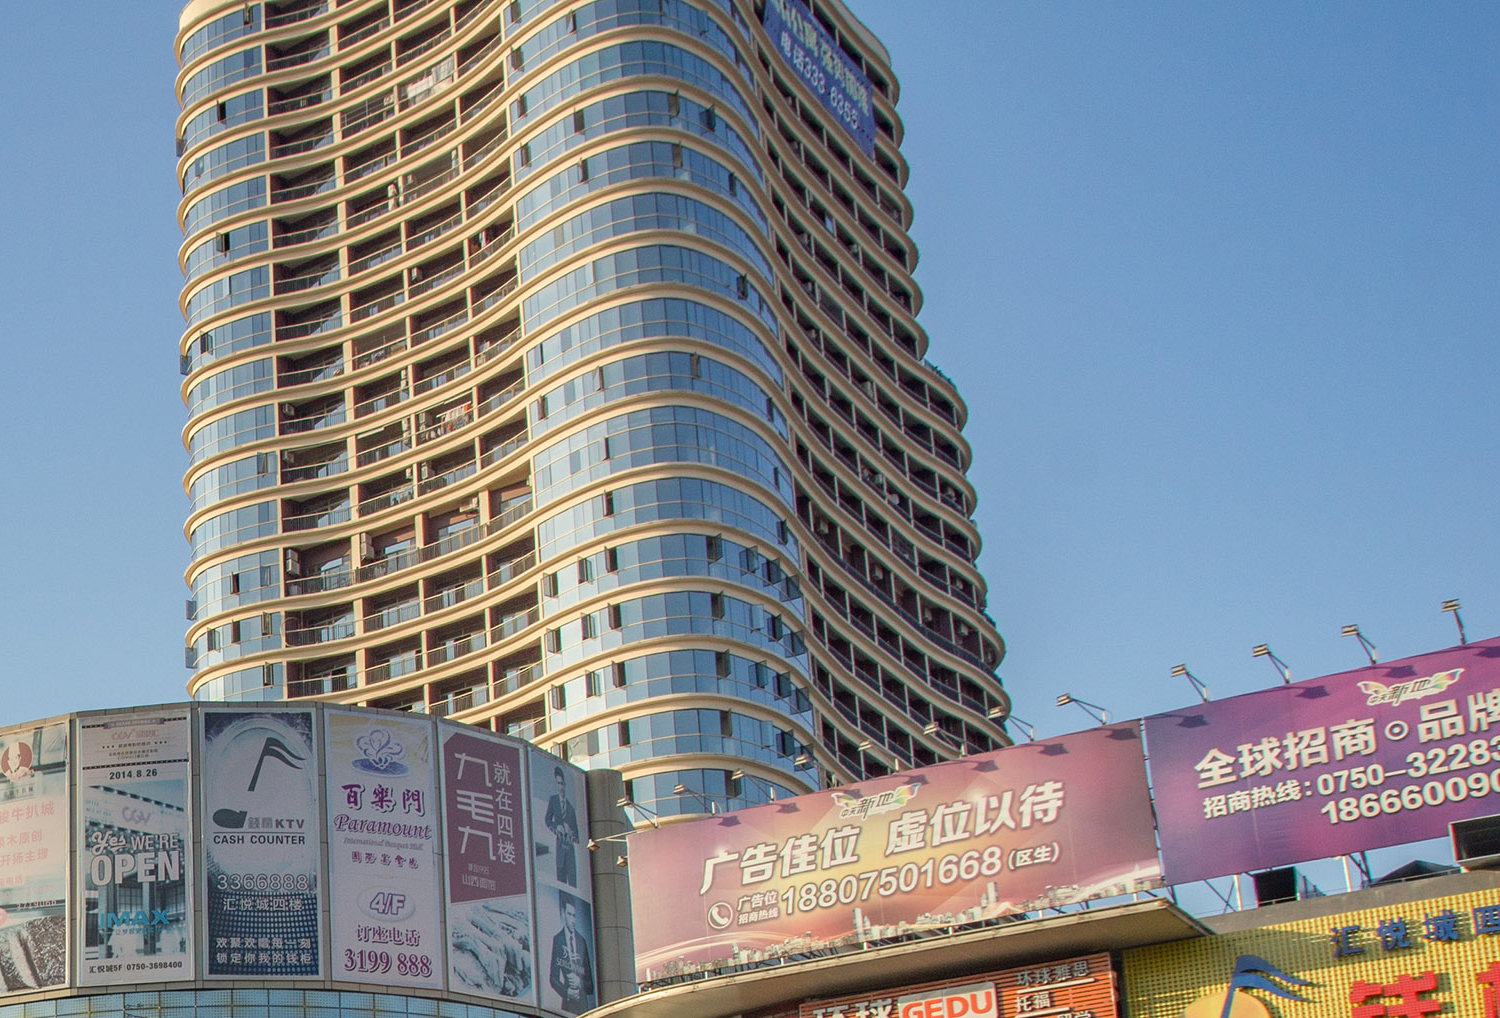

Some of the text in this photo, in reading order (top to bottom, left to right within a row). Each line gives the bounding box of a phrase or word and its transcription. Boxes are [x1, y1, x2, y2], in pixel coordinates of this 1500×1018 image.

[1194, 717, 1378, 790] 全球招商
[454, 752, 497, 861] 九毛九
[493, 761, 517, 866] 就在四楼
[213, 834, 306, 845] CASH COUNTER
[333, 813, 432, 841] Paramount
[700, 780, 1067, 896] 广告佳位 虚位以待
[90, 850, 181, 886] OPEN
[216, 873, 309, 891] 3366888
[780, 846, 1003, 916] 18807501668
[223, 898, 304, 911] 汇悦城四楼
[369, 891, 407, 916] 4/F
[737, 890, 779, 912] 广告位
[100, 909, 171, 929] IMAX
[738, 906, 780, 926] 招商热线
[356, 924, 421, 948] 订座电话
[1330, 904, 1500, 959] 汇悦城四
[216, 952, 312, 965] 锁定你我的钱柜
[344, 948, 433, 978] 3199 888
[1016, 960, 1091, 986] 环球雅思
[1015, 990, 1052, 1014] 托福
